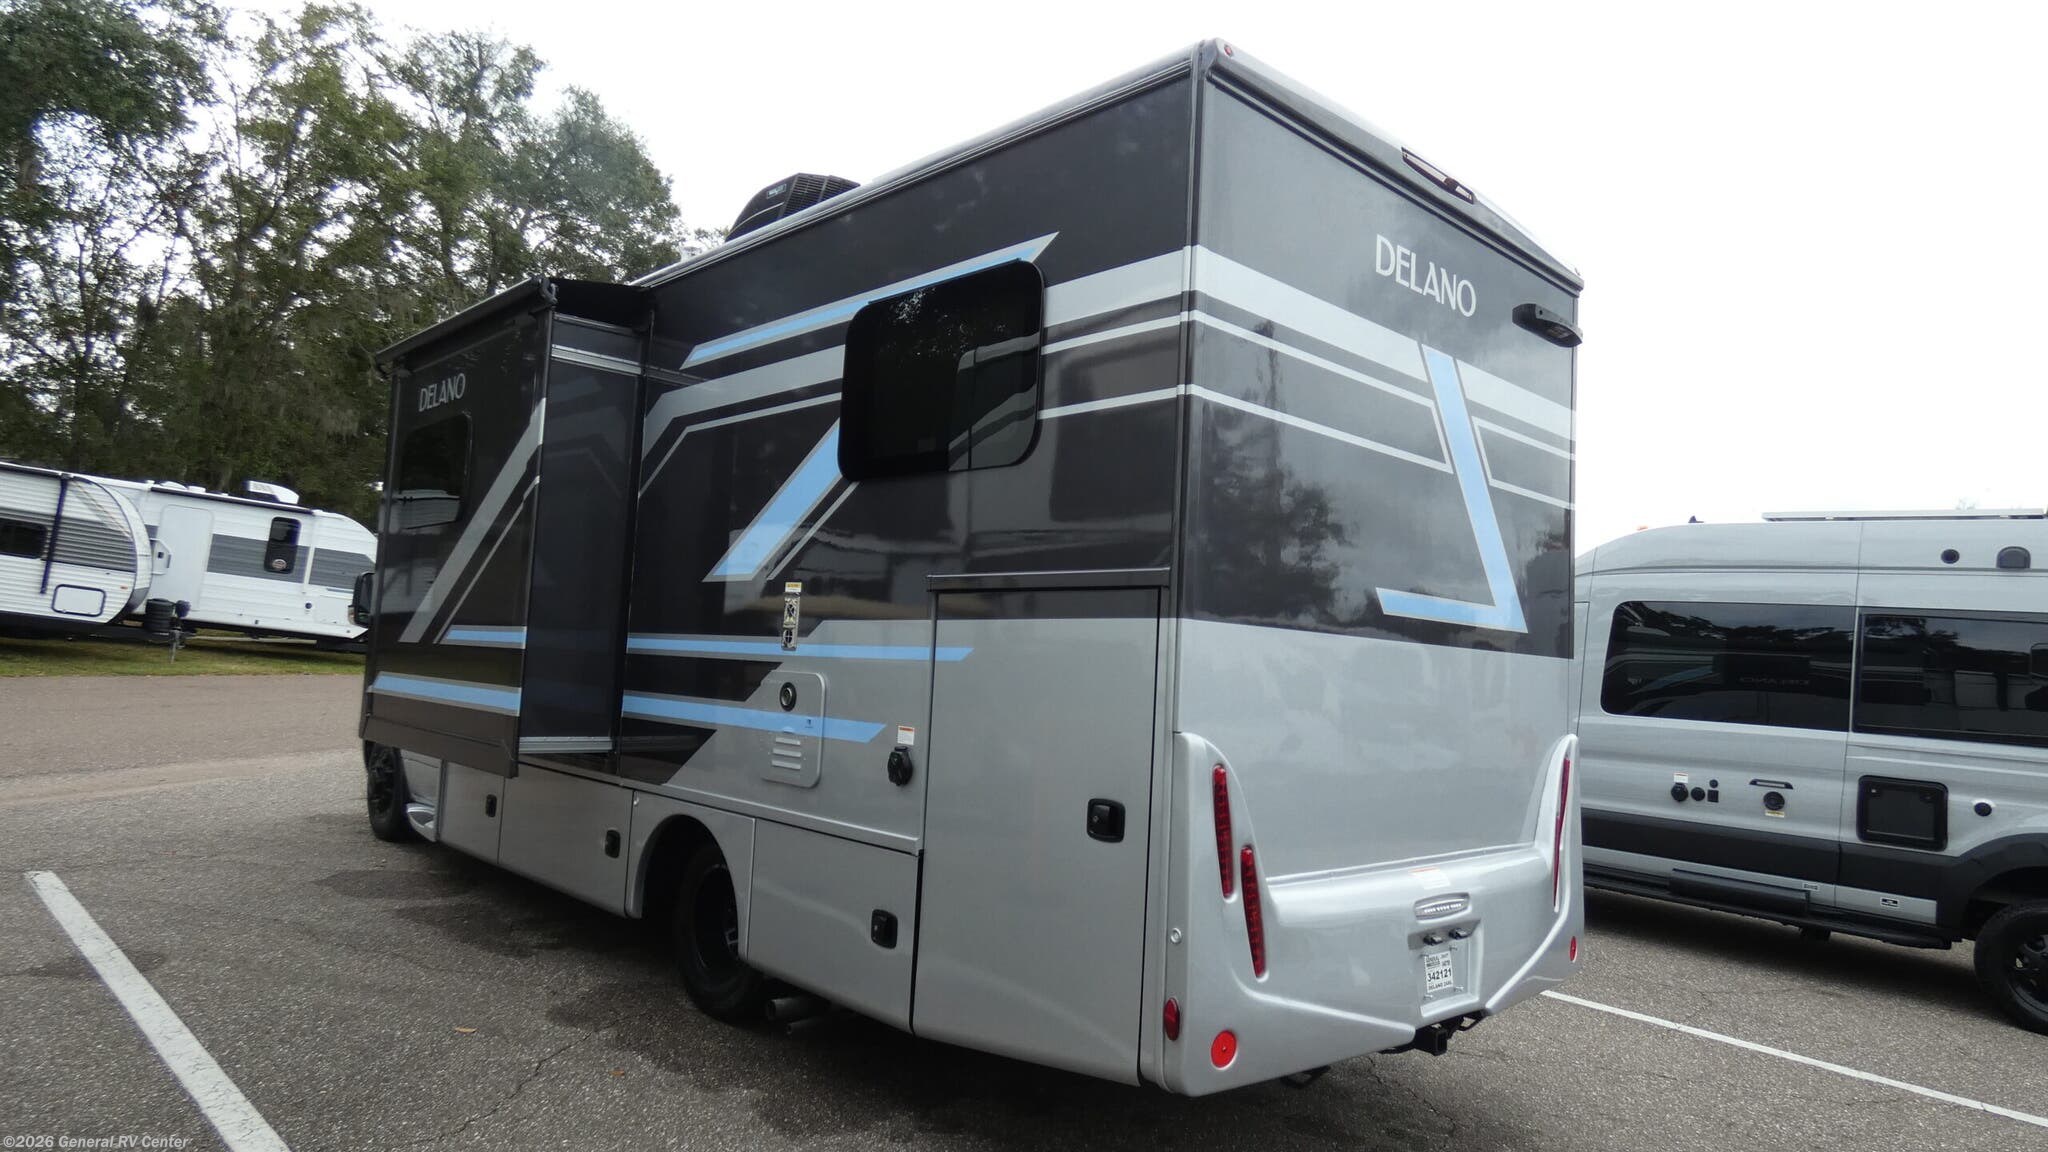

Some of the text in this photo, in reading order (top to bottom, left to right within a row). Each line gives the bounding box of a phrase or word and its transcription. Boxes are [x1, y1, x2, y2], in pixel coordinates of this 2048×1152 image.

[1375, 234, 1477, 318] DELANO
[418, 373, 466, 412] DELANO
[1427, 968, 1452, 982] 342121
